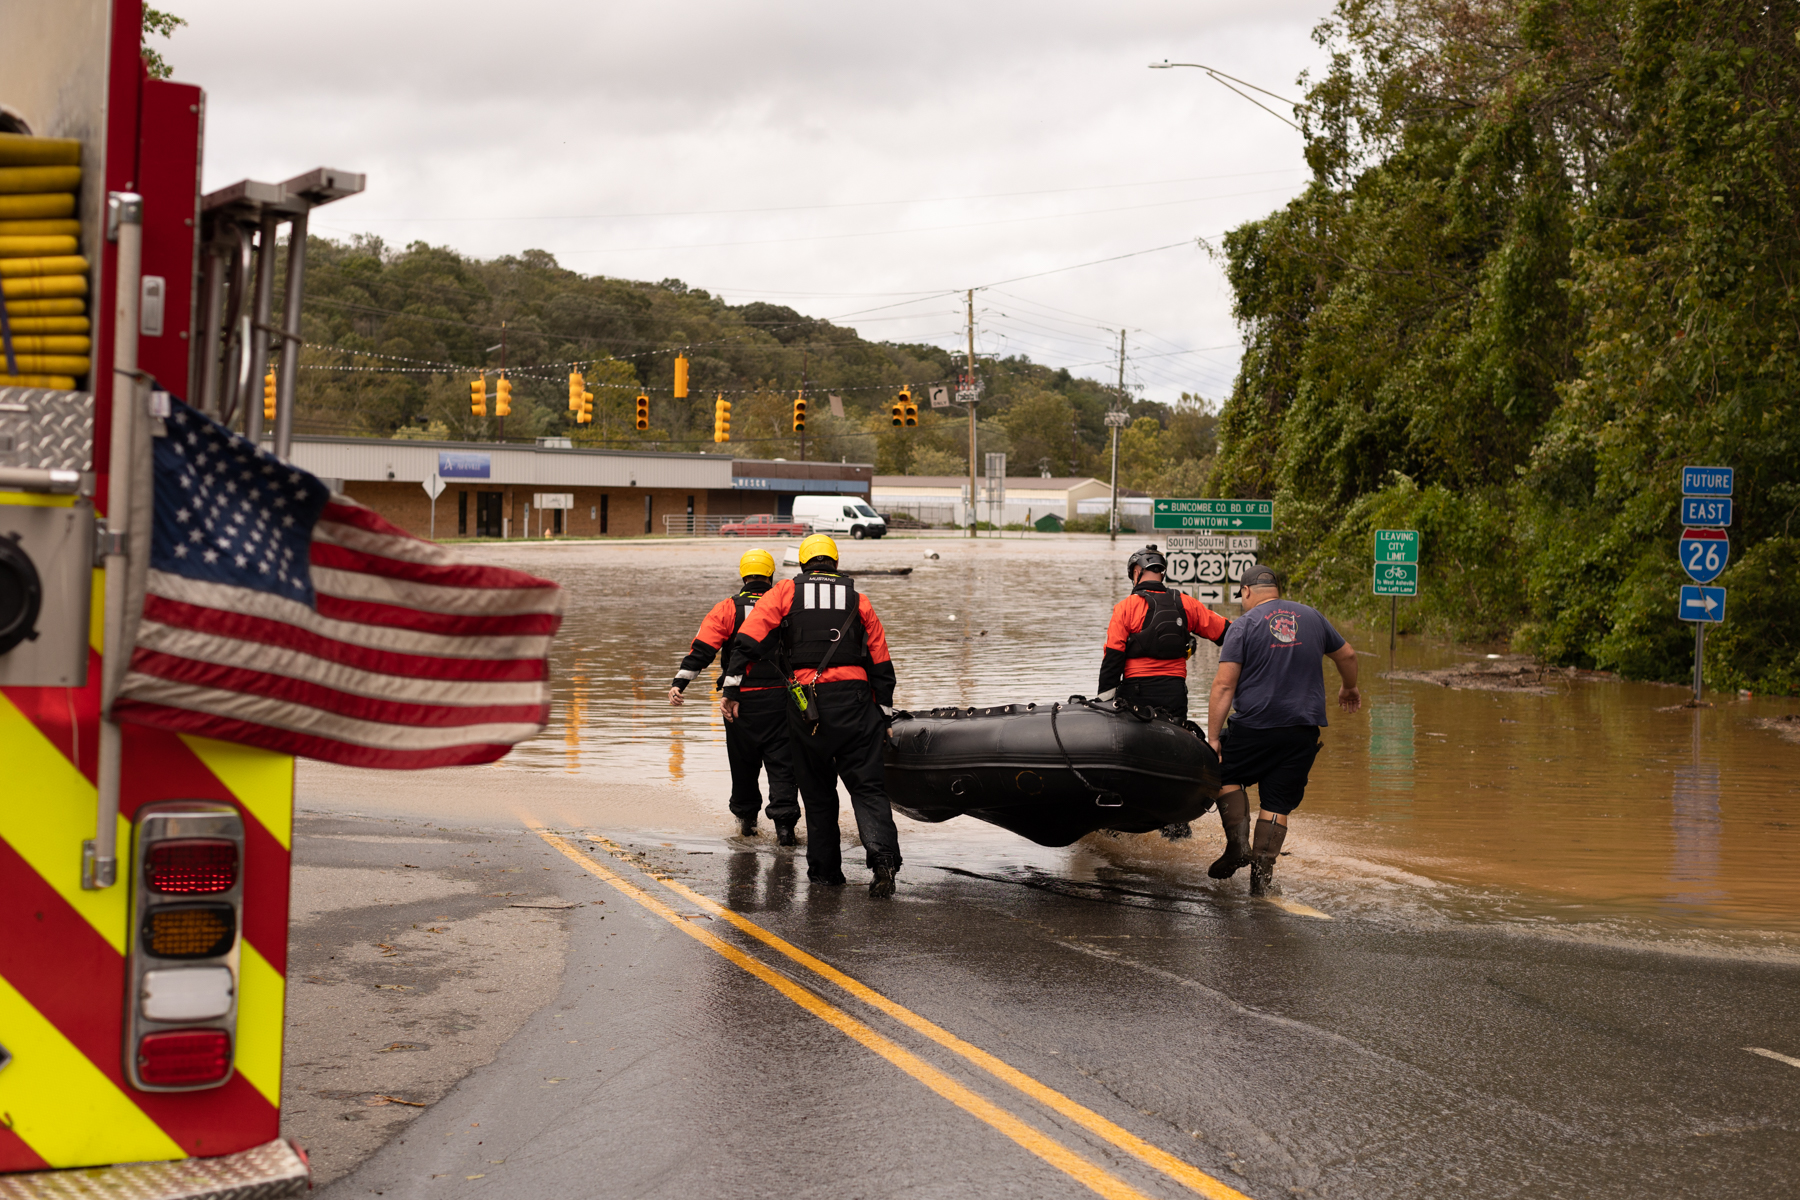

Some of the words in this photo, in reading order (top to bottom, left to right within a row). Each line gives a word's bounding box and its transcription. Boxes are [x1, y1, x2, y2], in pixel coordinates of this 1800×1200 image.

[738, 479, 766, 487] WESCO
[1686, 473, 1729, 488] FUTURE
[1171, 502, 1212, 512] BUNCOMBE
[1216, 503, 1227, 512] CO.
[1230, 503, 1242, 513] BD.
[1246, 503, 1256, 513] OF
[1259, 504, 1270, 513] ED.
[1689, 503, 1724, 519] EAST
[1182, 517, 1229, 526] DOWNTOWN
[1380, 532, 1414, 541] LEAVING
[1168, 538, 1195, 547] SOUTH
[1198, 538, 1224, 547] SOUTH
[1232, 539, 1253, 548] EAST
[1388, 542, 1405, 550] CITY
[1386, 552, 1406, 561] LIMIT
[1688, 542, 1719, 571] 26
[1173, 559, 1189, 576] 19
[1200, 559, 1222, 576] 23
